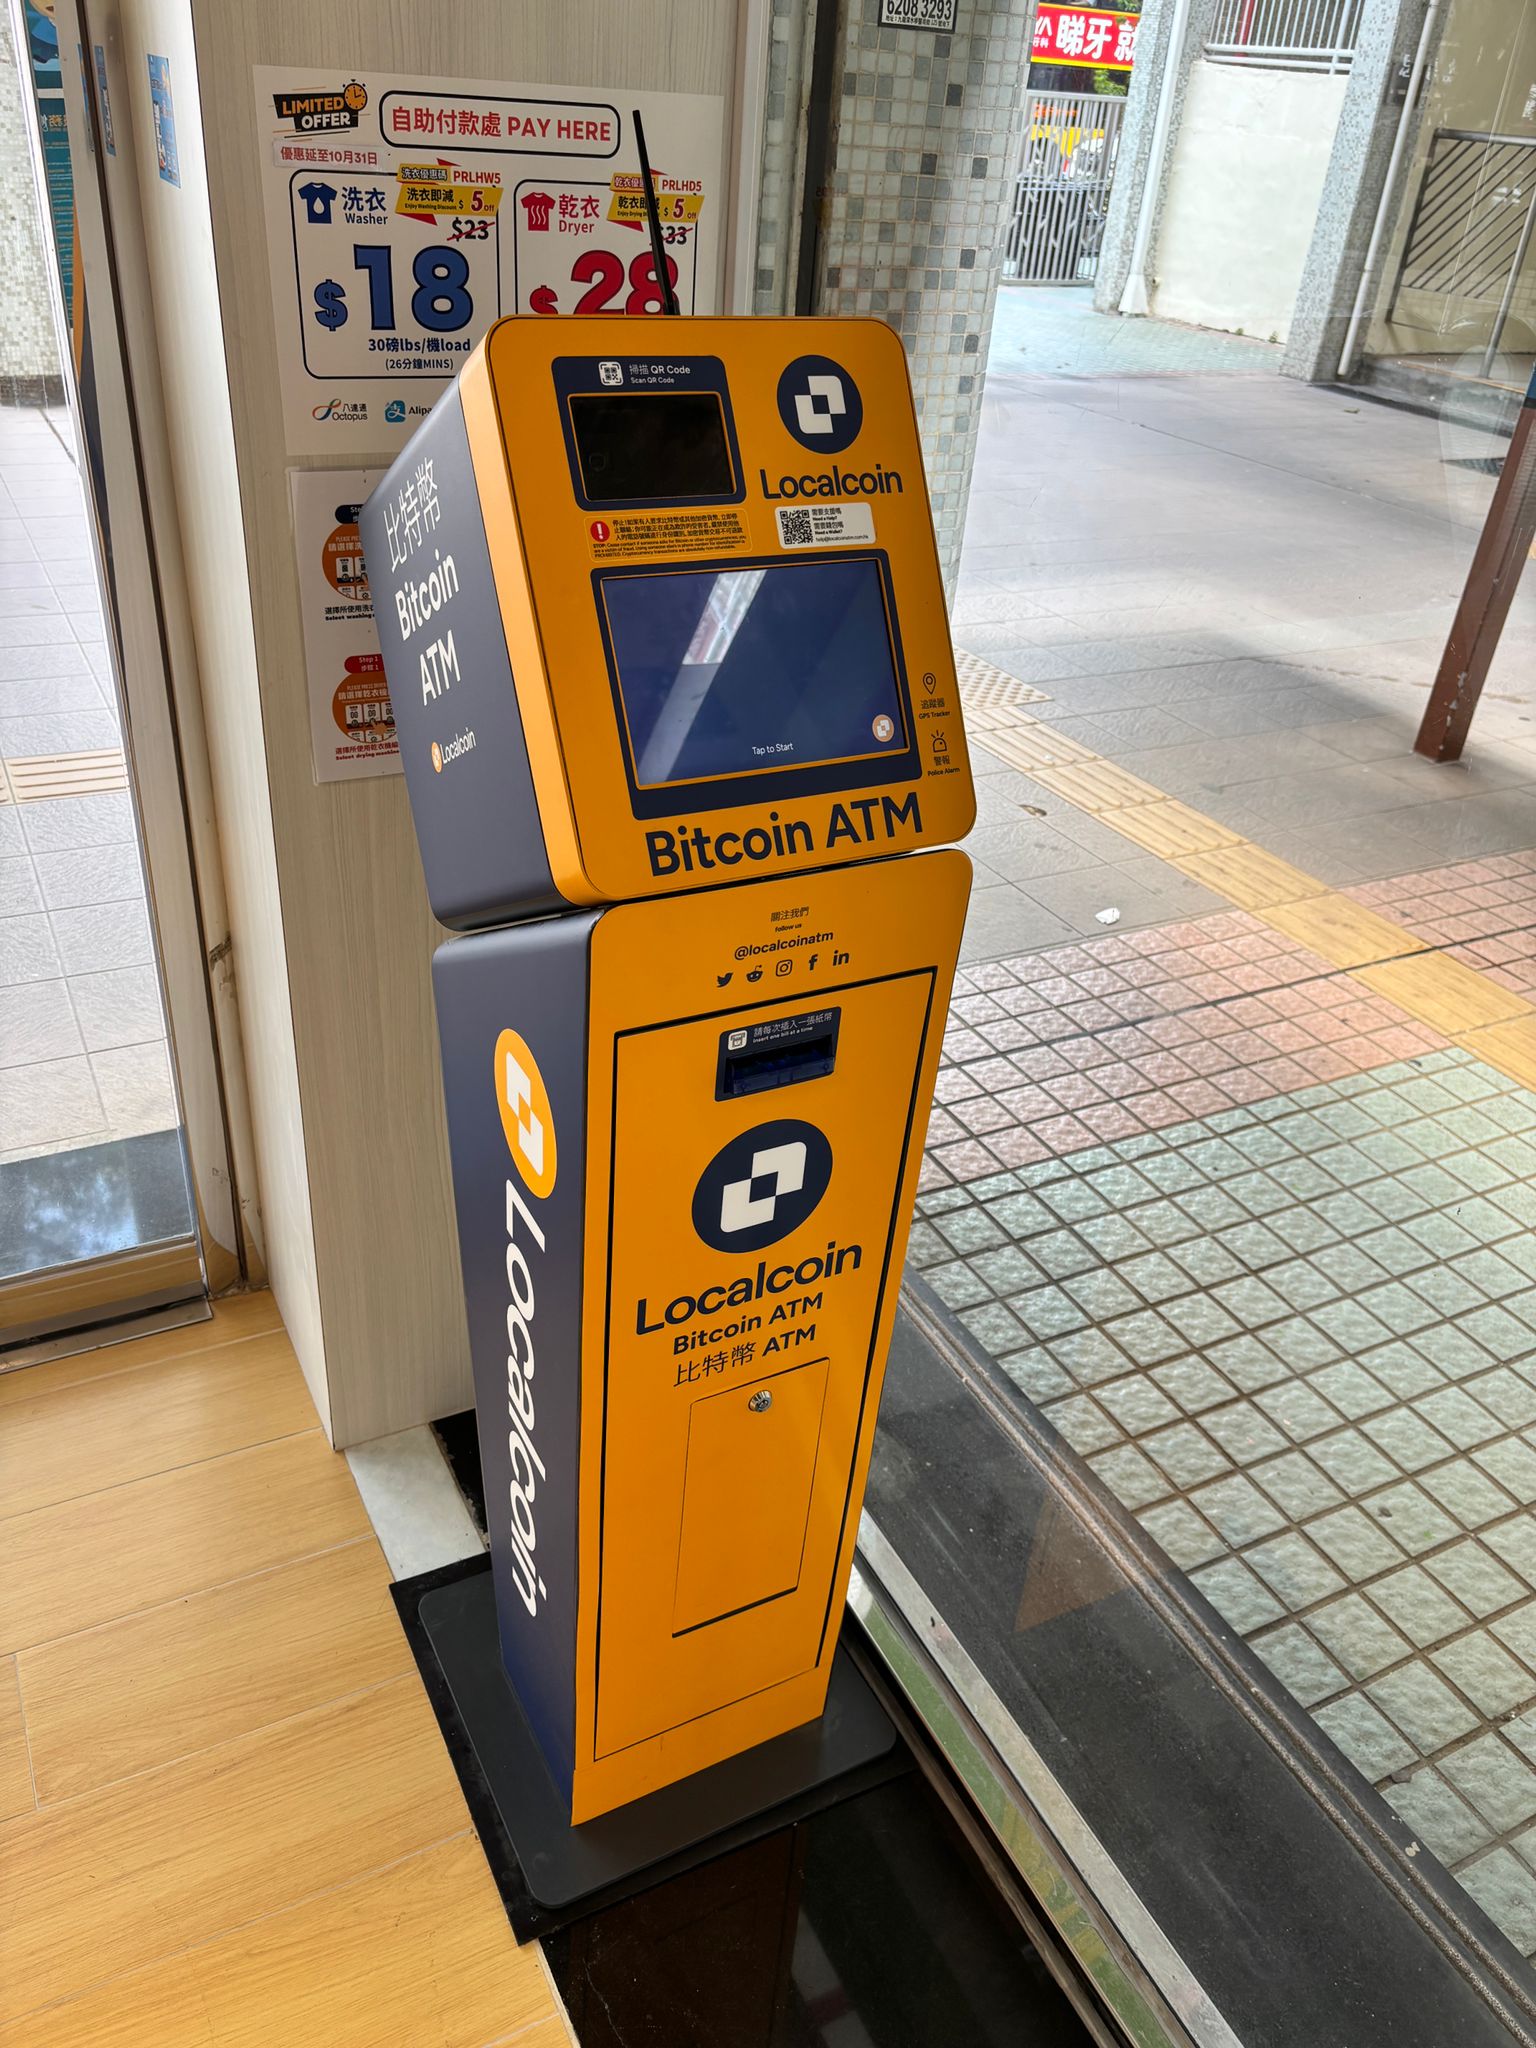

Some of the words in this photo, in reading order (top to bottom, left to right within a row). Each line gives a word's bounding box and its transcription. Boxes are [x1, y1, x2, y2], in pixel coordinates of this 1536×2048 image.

[282, 96, 344, 115] LIMITED
[301, 112, 350, 129] OFFER
[392, 106, 501, 137] 自助付款處
[507, 116, 551, 138] PAY
[557, 119, 611, 141] HERE
[281, 146, 378, 165] 優惠延至10月31日
[453, 171, 501, 184] PRLHW5
[662, 179, 702, 192] PRLHD5
[342, 187, 387, 212] 洗衣
[407, 187, 454, 203] 洗衣即減
[471, 190, 483, 212] 5
[558, 195, 600, 219] 乾衣
[673, 198, 685, 219] 5
[345, 213, 388, 225] Washer
[558, 220, 594, 236] Dryer
[650, 226, 687, 245] 33
[630, 376, 647, 384] Scan
[647, 376, 657, 384] QR
[657, 376, 675, 384] Code
[650, 365, 665, 374] QR
[666, 365, 691, 374] Code
[332, 412, 368, 422] Octopus
[760, 463, 903, 500] Localcoin
[383, 457, 442, 573] 比特幣
[395, 549, 459, 641] Bitcoin
[419, 630, 461, 706] ATM
[441, 727, 476, 764] Localcoin
[752, 746, 766, 756] Tap
[766, 745, 775, 753] to
[775, 742, 794, 752] Start
[944, 767, 960, 775] Alarm
[645, 811, 814, 877] Bitcoin
[825, 791, 923, 848] ATM
[774, 924, 794, 933] follow
[734, 931, 834, 960] @localcoinatm
[635, 1240, 862, 1335] Localcoin
[673, 1314, 761, 1355] Bitcoin
[768, 1292, 823, 1325] ATM
[673, 1341, 756, 1387] 比特幣
[762, 1324, 816, 1357] ATM
[505, 1178, 547, 1618] Localcoin
